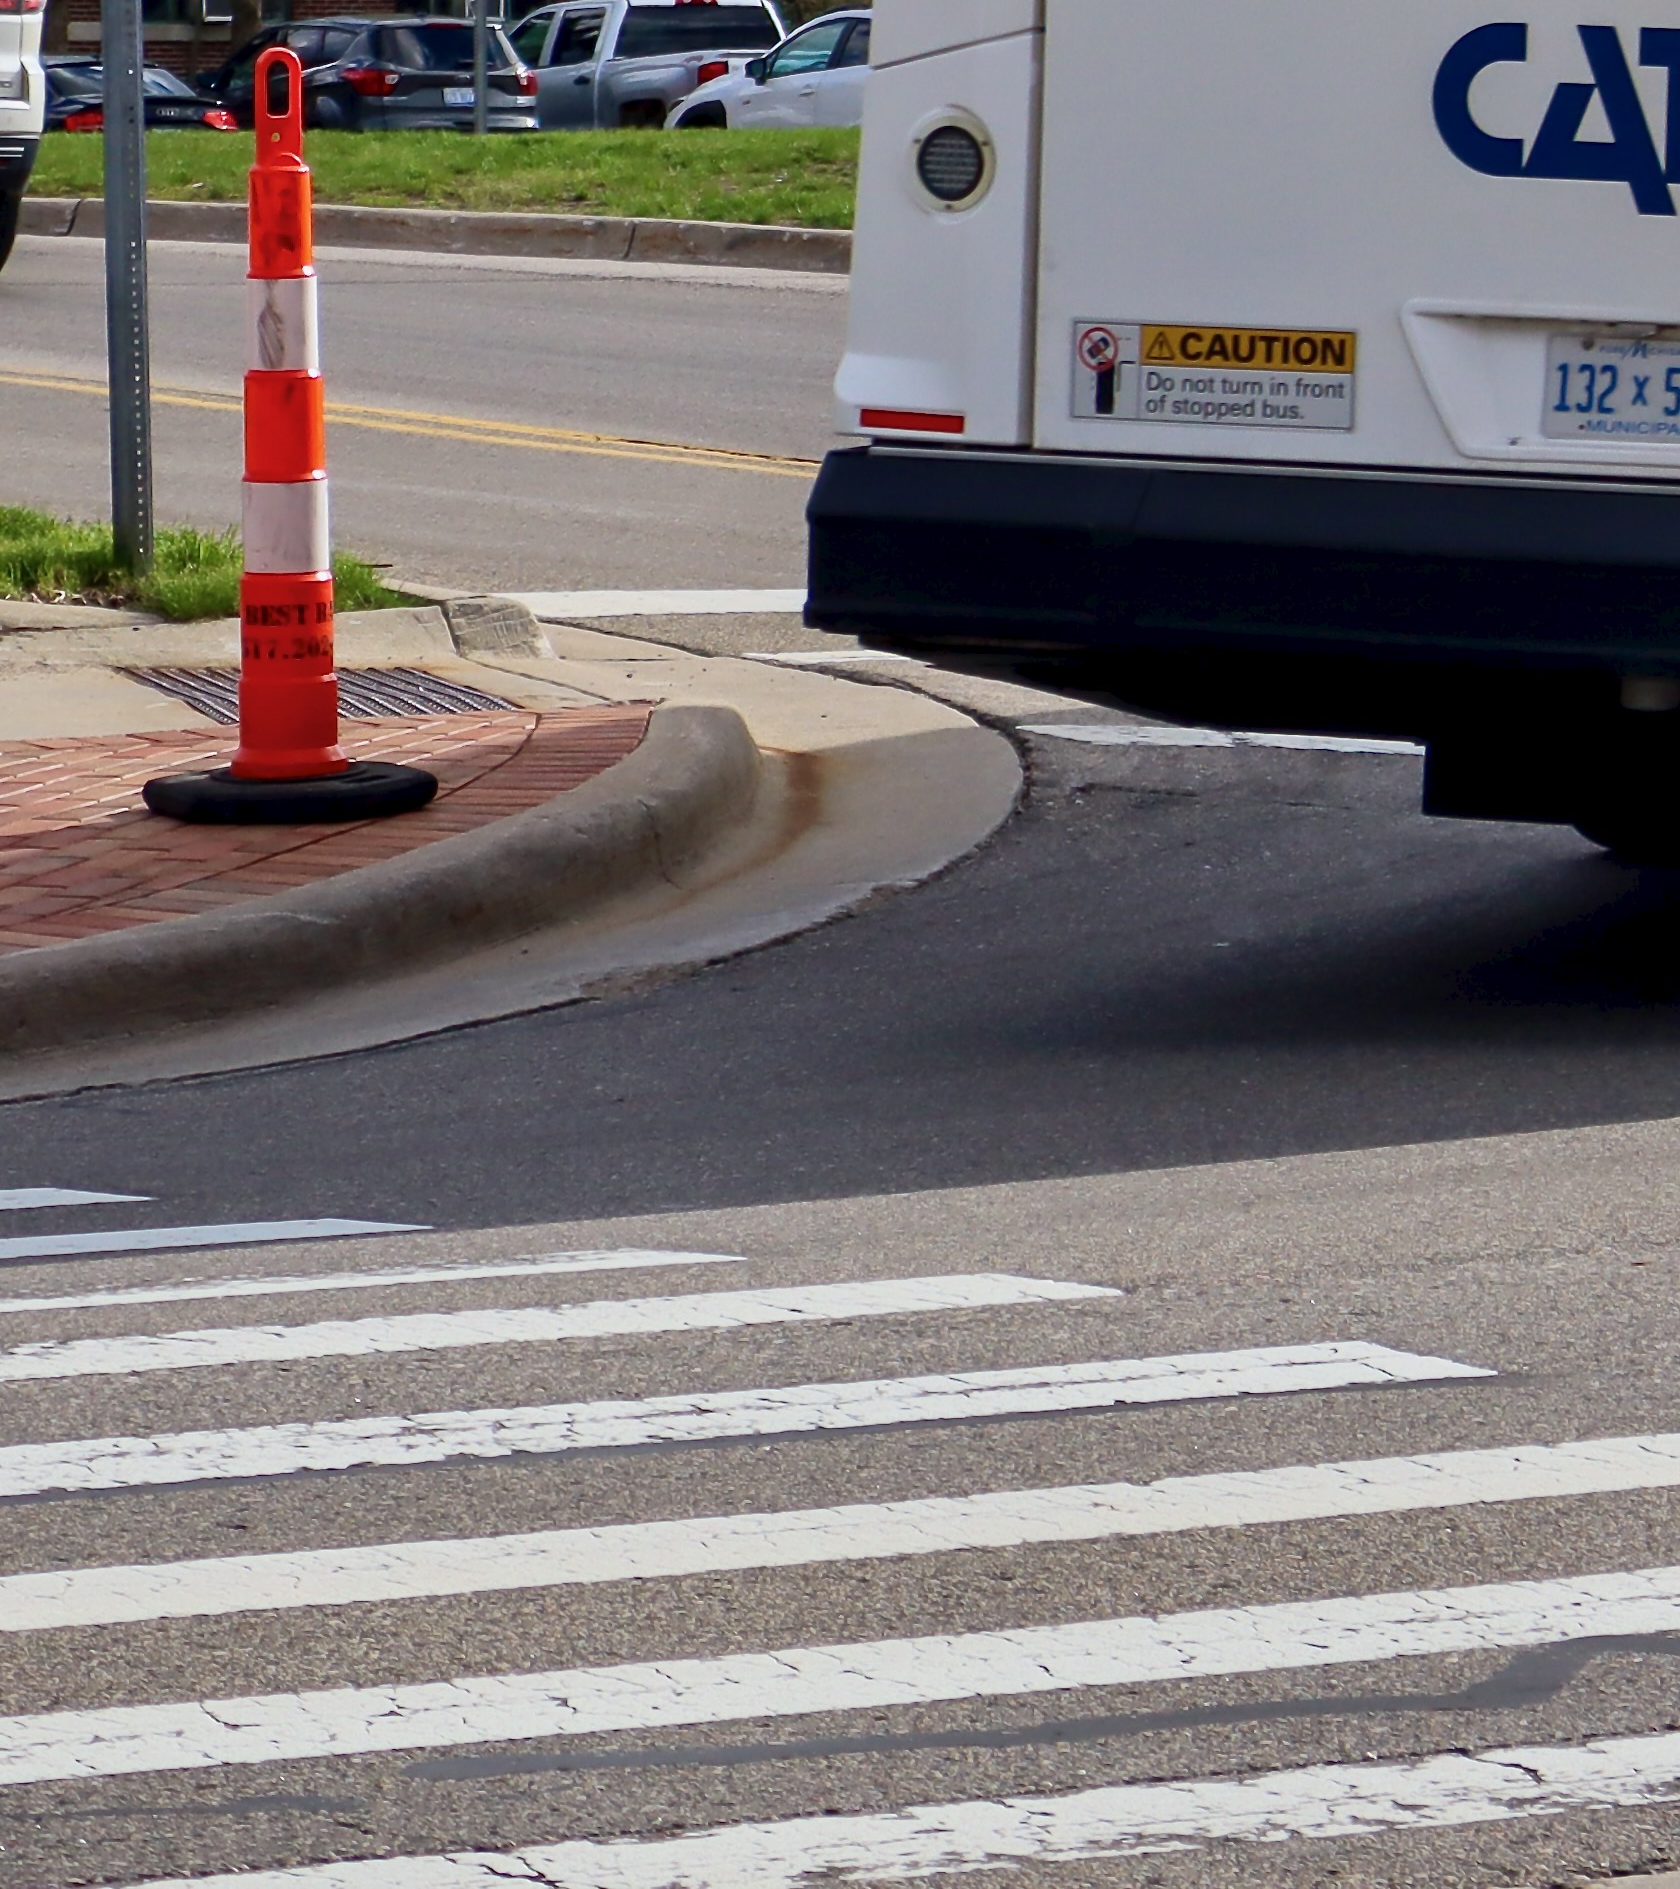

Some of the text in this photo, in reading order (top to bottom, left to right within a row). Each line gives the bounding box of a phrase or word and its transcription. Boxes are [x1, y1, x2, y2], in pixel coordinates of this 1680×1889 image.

[1179, 331, 1347, 367] CAUTION
[1146, 371, 1345, 400] Do not turn in front
[1553, 362, 1619, 415] 132
[1145, 394, 1305, 421] of stopped bus.
[245, 603, 308, 626] BEST
